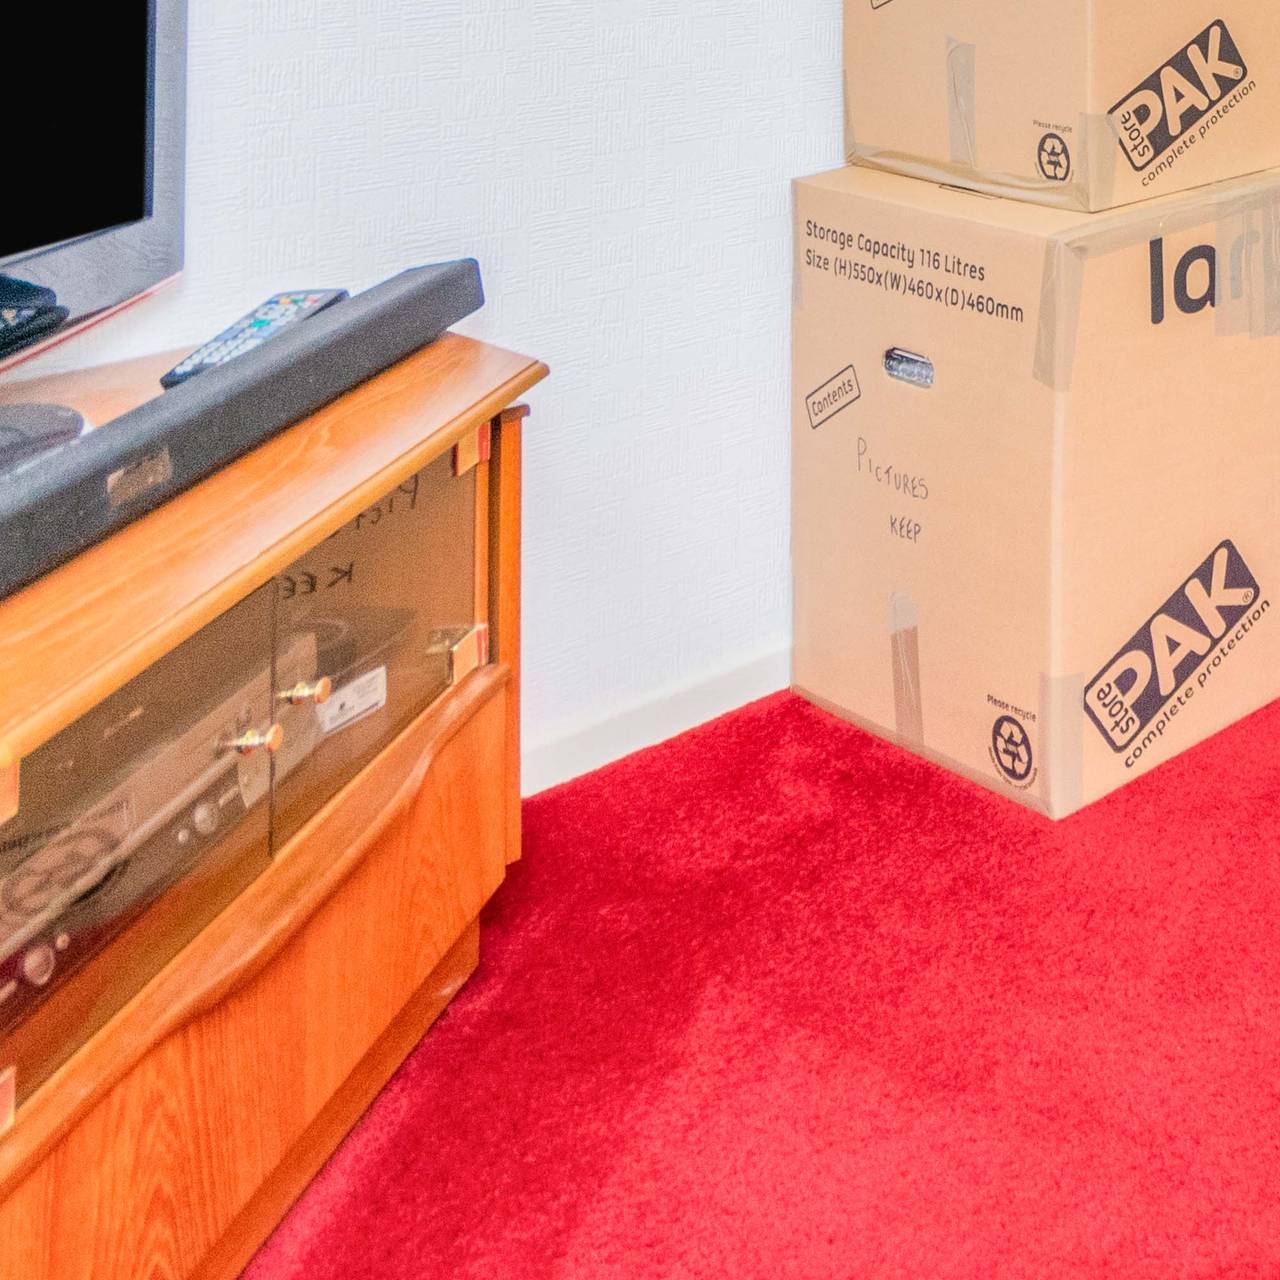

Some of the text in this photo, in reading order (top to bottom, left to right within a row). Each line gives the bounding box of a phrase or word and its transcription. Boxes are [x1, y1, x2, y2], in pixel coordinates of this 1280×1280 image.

[1119, 25, 1244, 157] store PAK
[1141, 133, 1197, 187] complete
[1198, 80, 1257, 139] protection
[805, 220, 985, 281] Storage Capacity 116 Litres
[805, 249, 1024, 323] Size (H)550x(W)460x(D)460mm
[811, 378, 854, 417] Contents
[890, 514, 922, 544] KEEP
[1096, 547, 1255, 734] store PAK
[1124, 598, 1271, 769] complete protection
